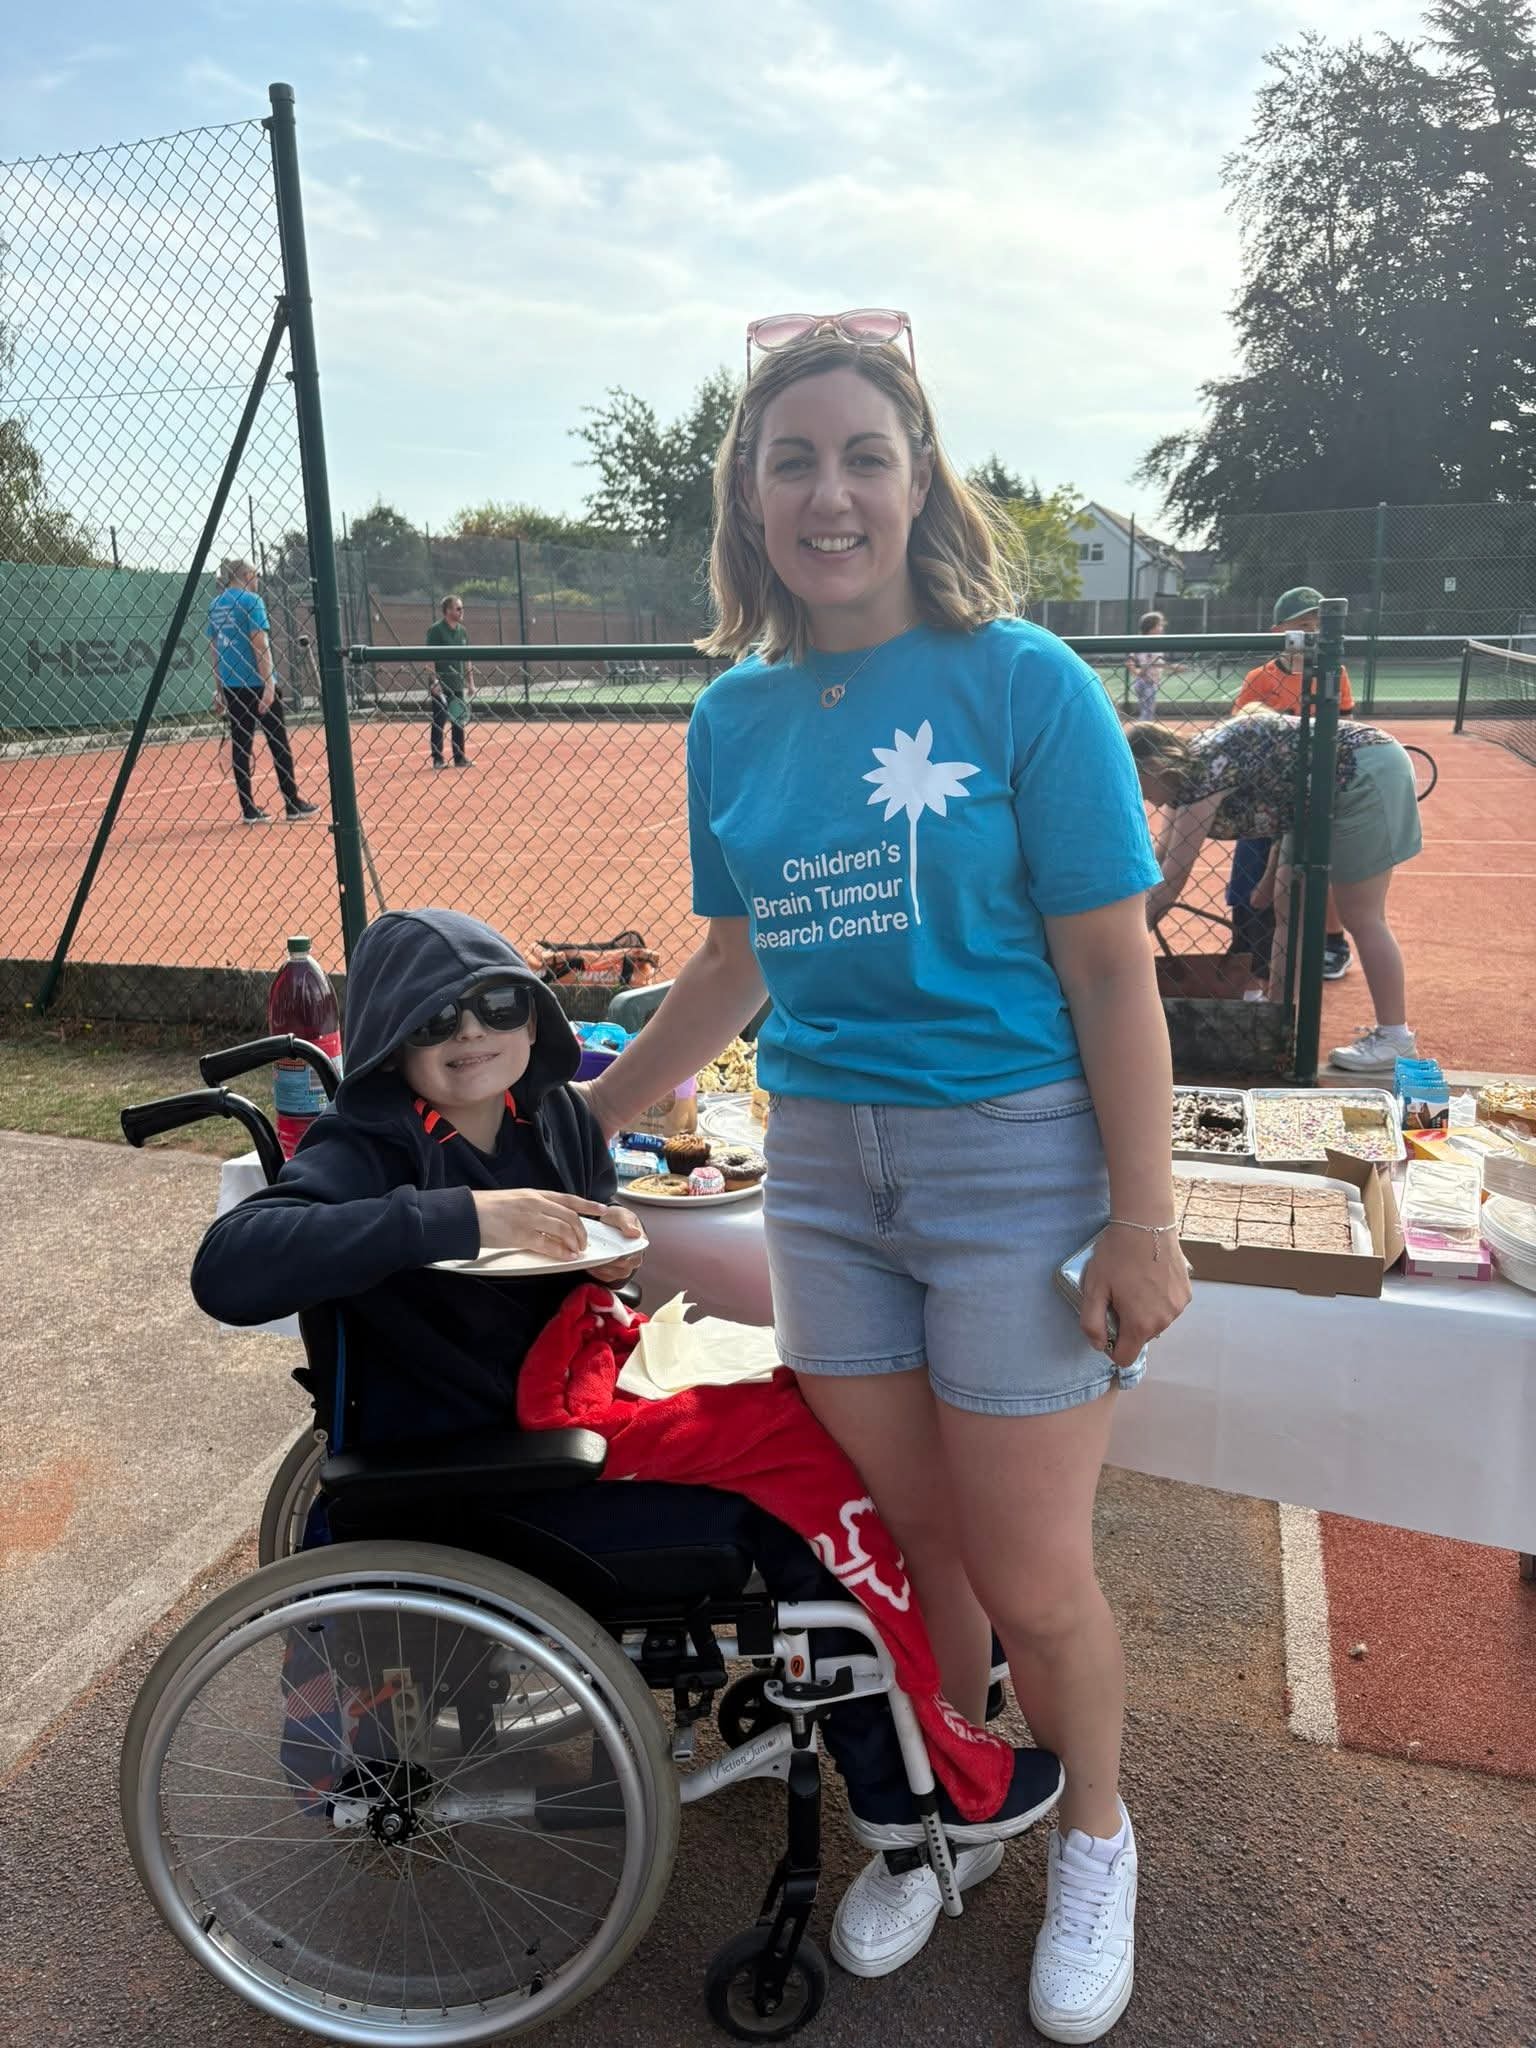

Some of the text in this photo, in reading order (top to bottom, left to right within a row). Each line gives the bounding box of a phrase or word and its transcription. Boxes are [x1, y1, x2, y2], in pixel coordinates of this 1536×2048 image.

[28, 639, 195, 677] HEAD
[783, 841, 901, 884] Children's
[753, 877, 902, 919] Brain Tumour
[828, 909, 909, 938] Centre
